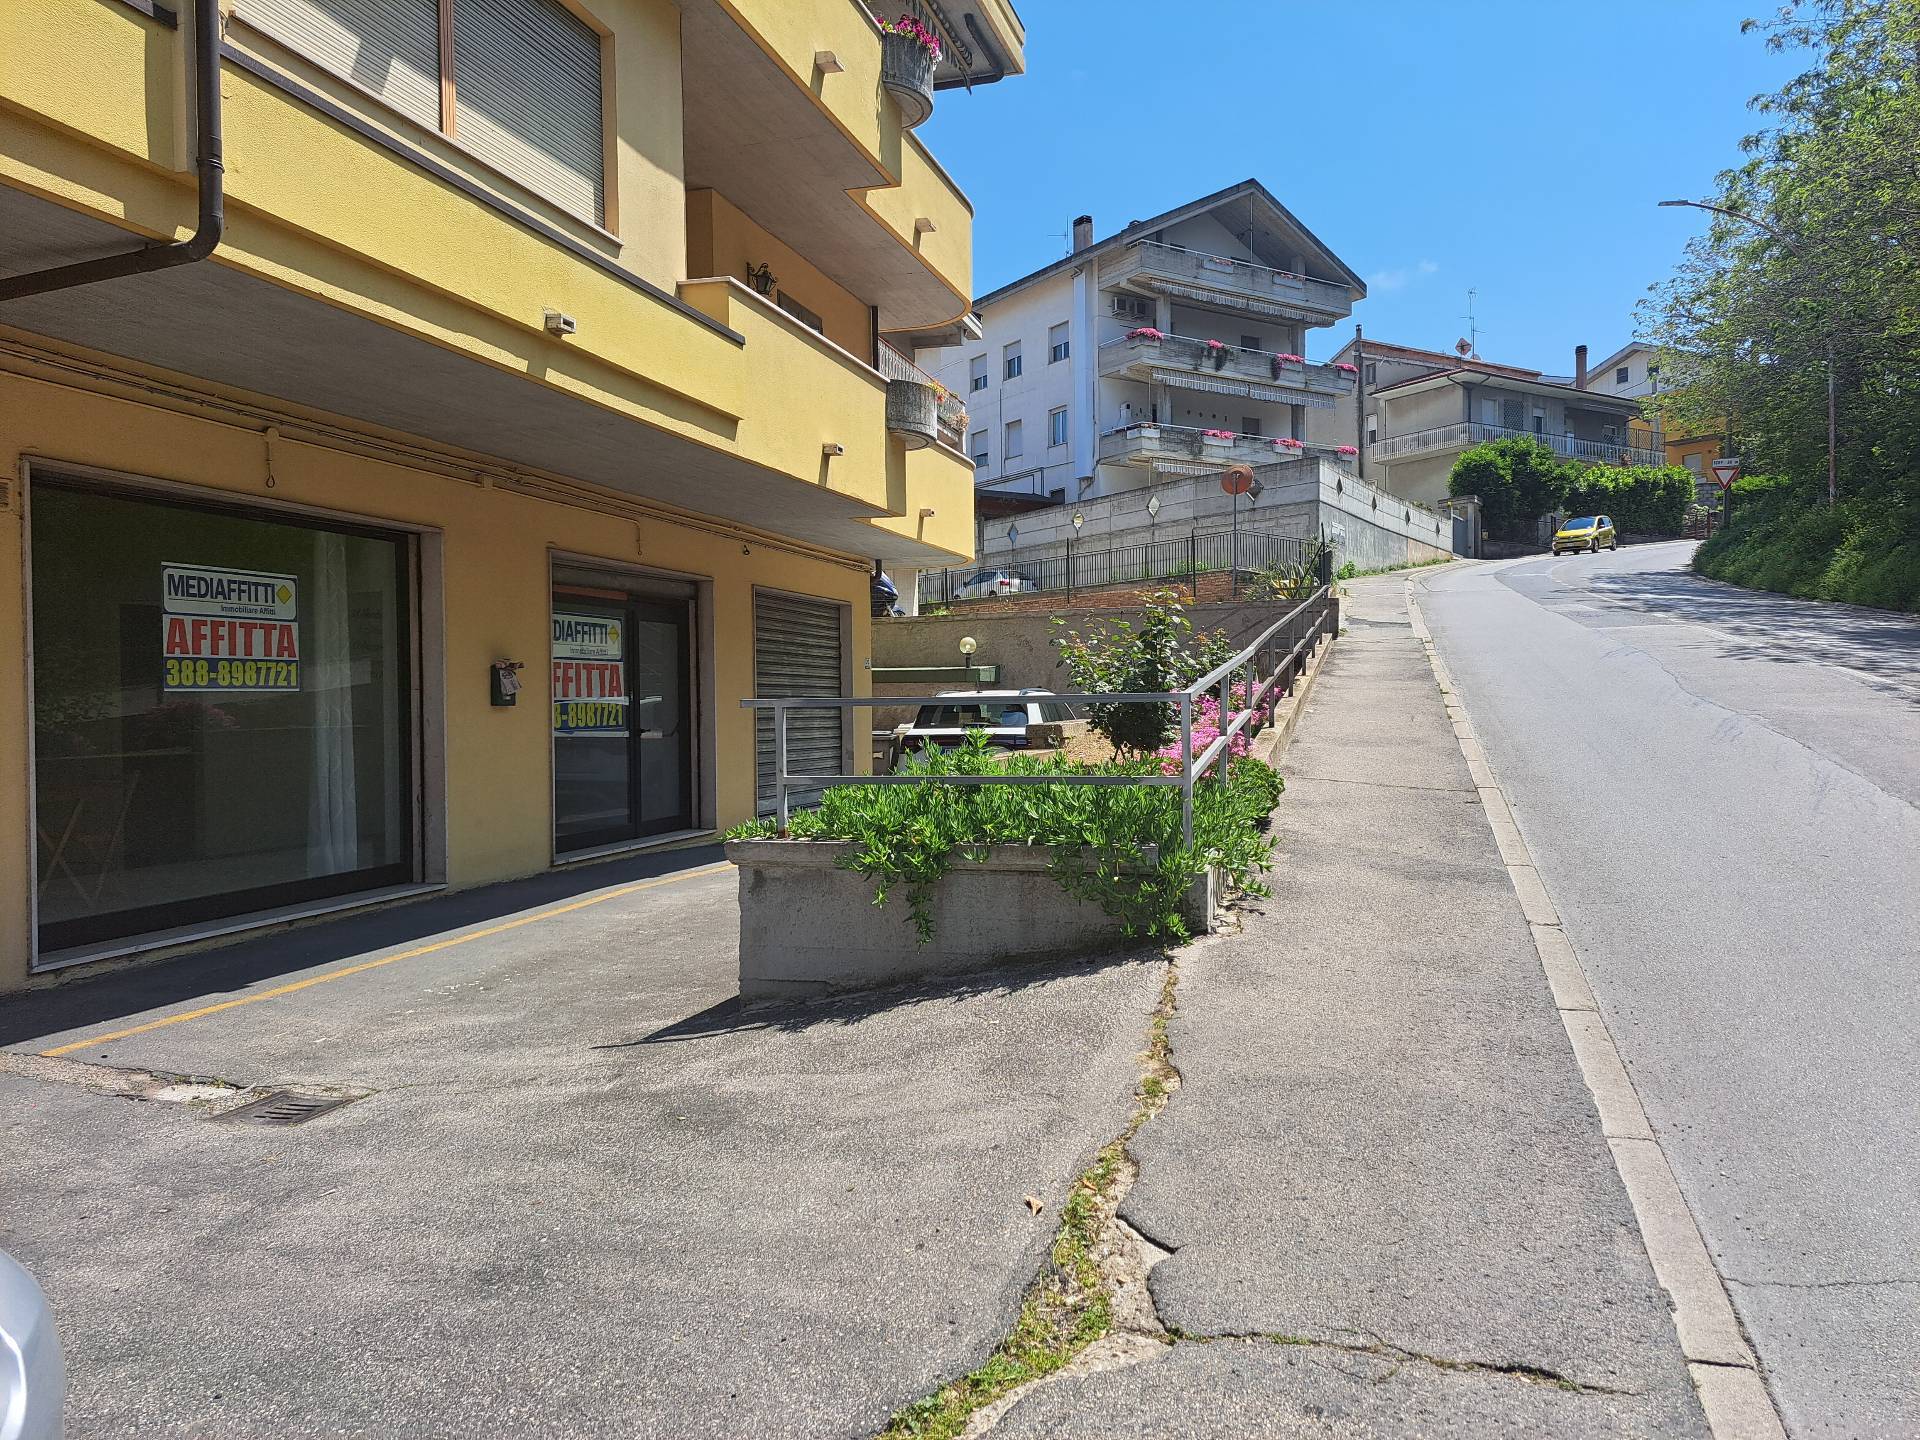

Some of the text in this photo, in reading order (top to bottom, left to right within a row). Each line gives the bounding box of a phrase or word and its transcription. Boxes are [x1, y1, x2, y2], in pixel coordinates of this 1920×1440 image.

[167, 573, 276, 604] MEDIAFFITTI
[220, 604, 258, 614] Immobiliare
[166, 617, 297, 658] AFFITTA
[166, 659, 297, 687] 388-8987721
